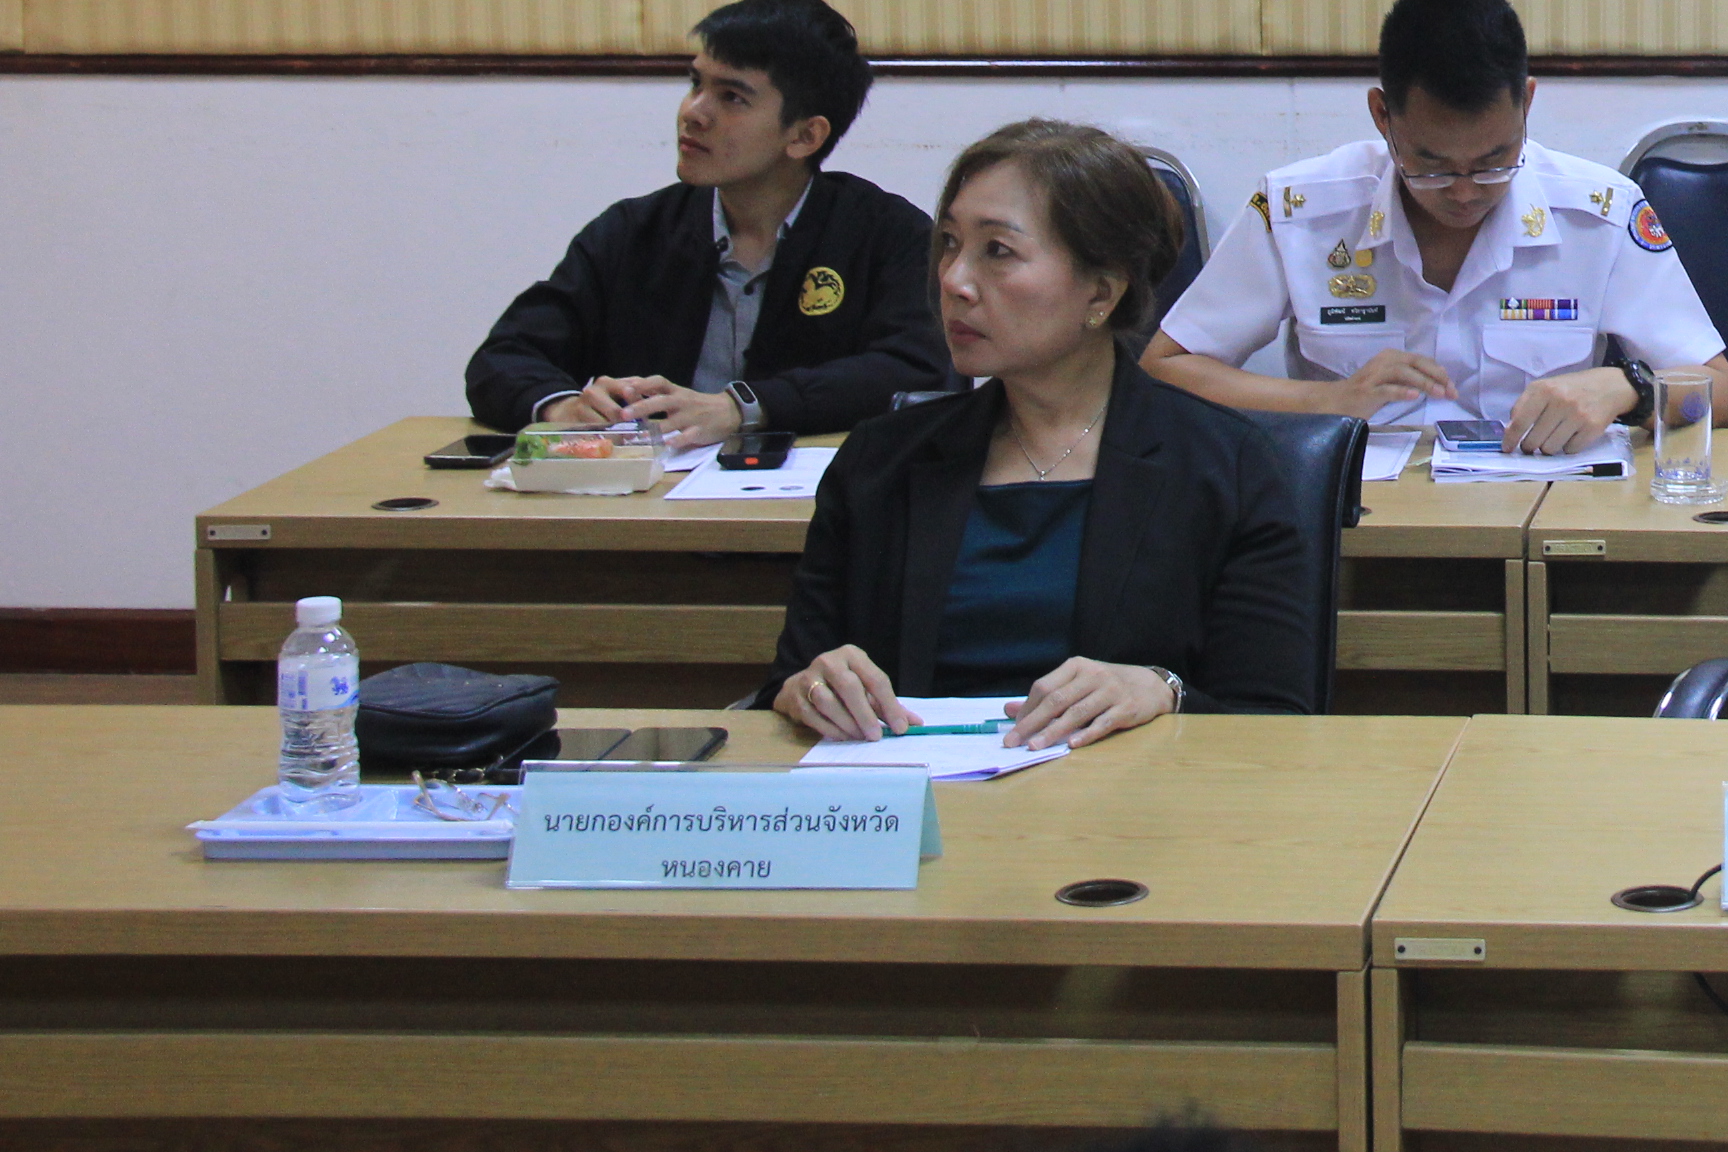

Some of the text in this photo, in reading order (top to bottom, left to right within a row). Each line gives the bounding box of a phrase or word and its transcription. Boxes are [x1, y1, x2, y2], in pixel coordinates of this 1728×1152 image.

[543, 803, 900, 834] นายกองค์การบริหารส่วนจังหวัด
[661, 856, 772, 880] หนองคาย
